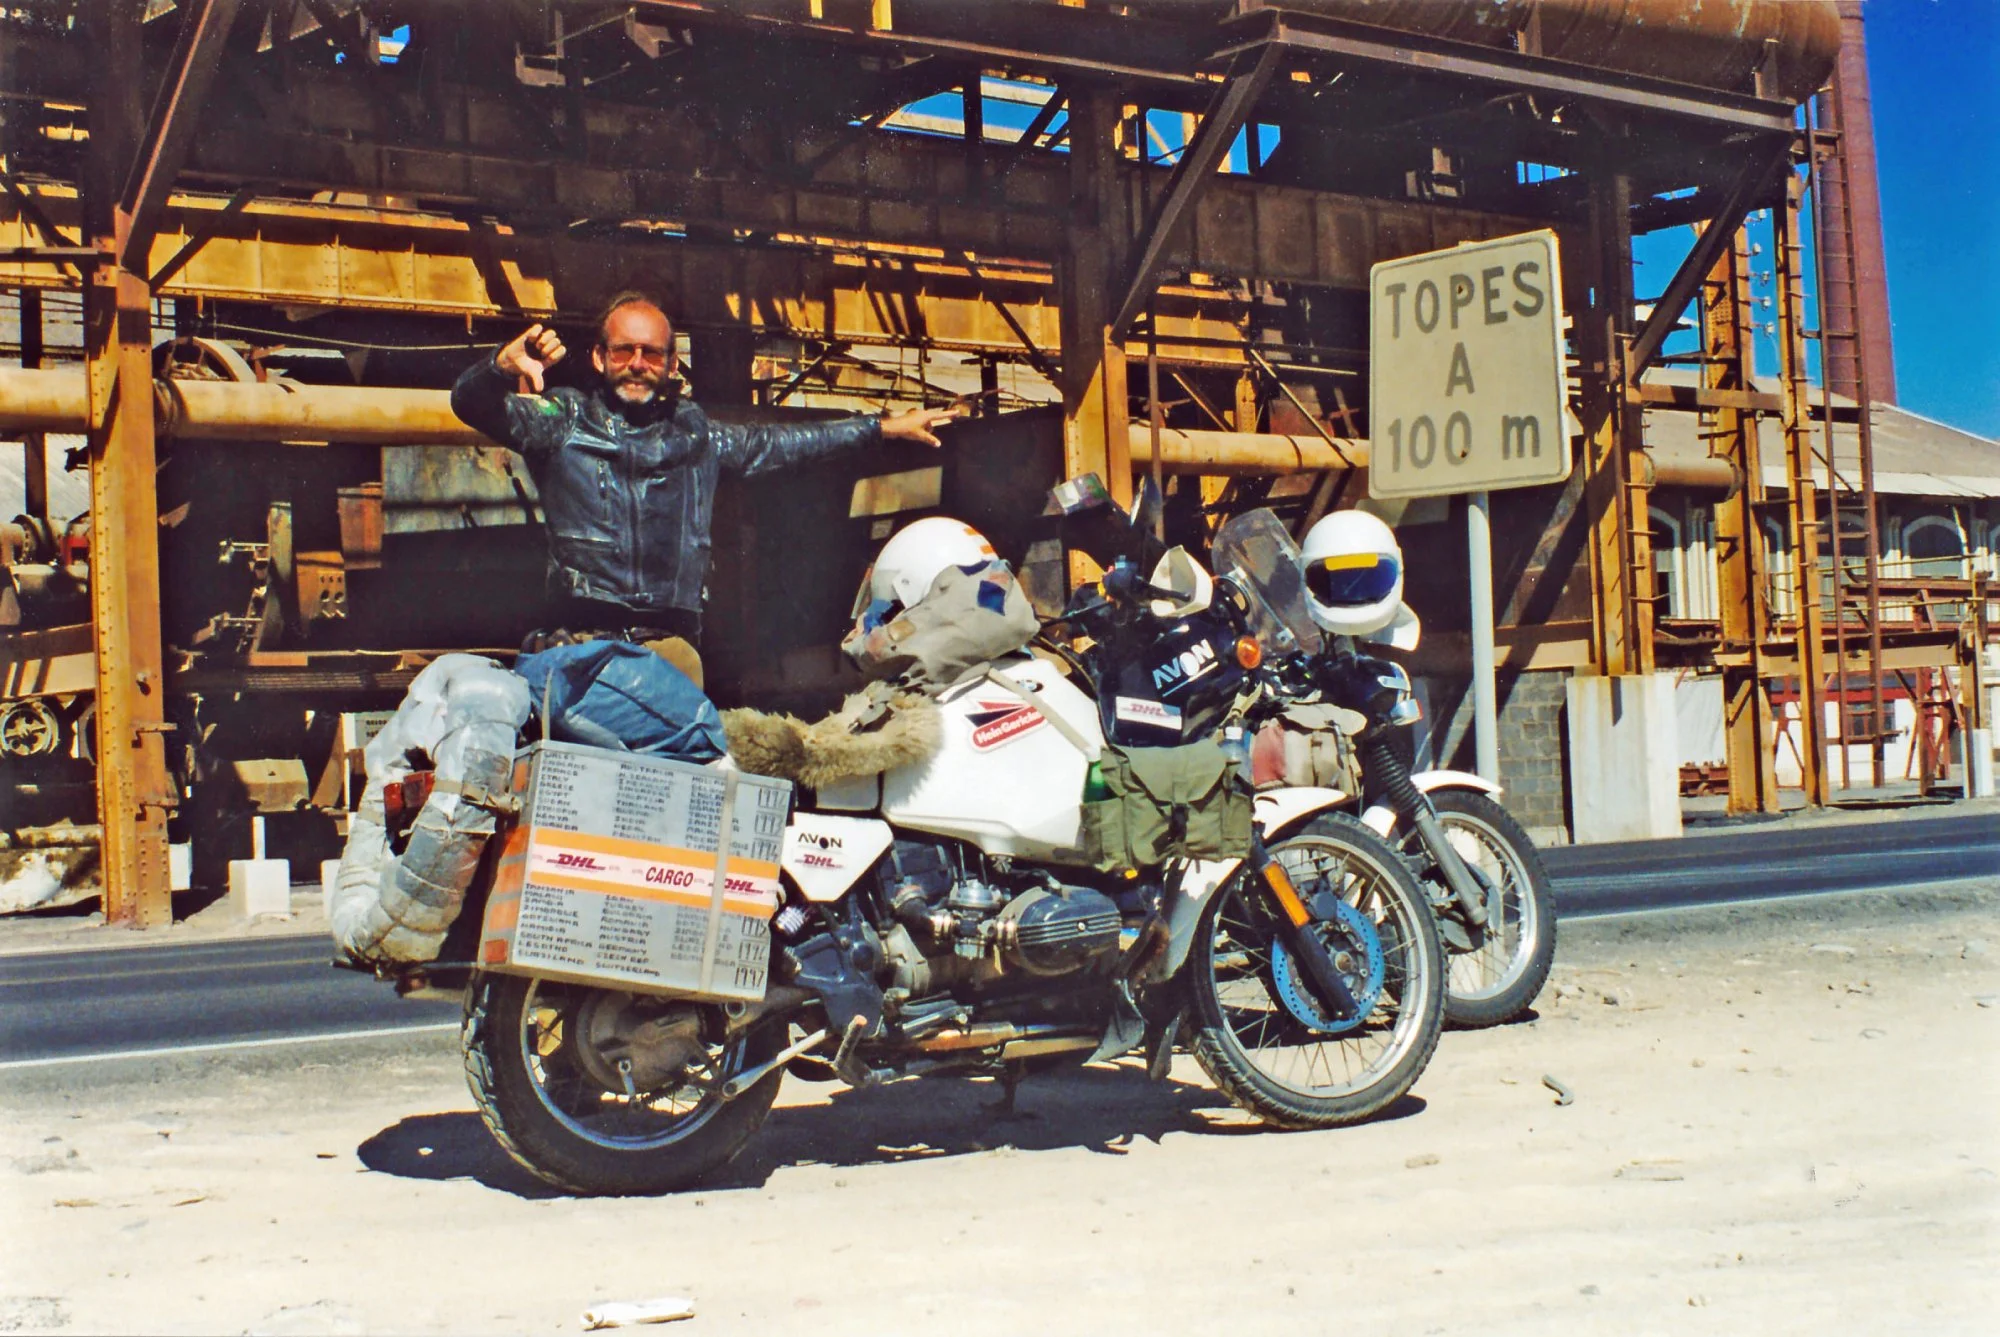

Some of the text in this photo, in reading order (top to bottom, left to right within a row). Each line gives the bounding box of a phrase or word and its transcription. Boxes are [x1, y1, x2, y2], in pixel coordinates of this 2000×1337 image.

[1385, 261, 1544, 339] TOPES
[1445, 341, 1475, 397] A
[1387, 411, 1540, 473] 100 m
[1152, 638, 1215, 690] AVON
[798, 832, 843, 849] AVON
[799, 853, 840, 868] DHL
[553, 853, 601, 870] DHL
[645, 866, 694, 887] CARGO
[735, 967, 764, 987] 1997
